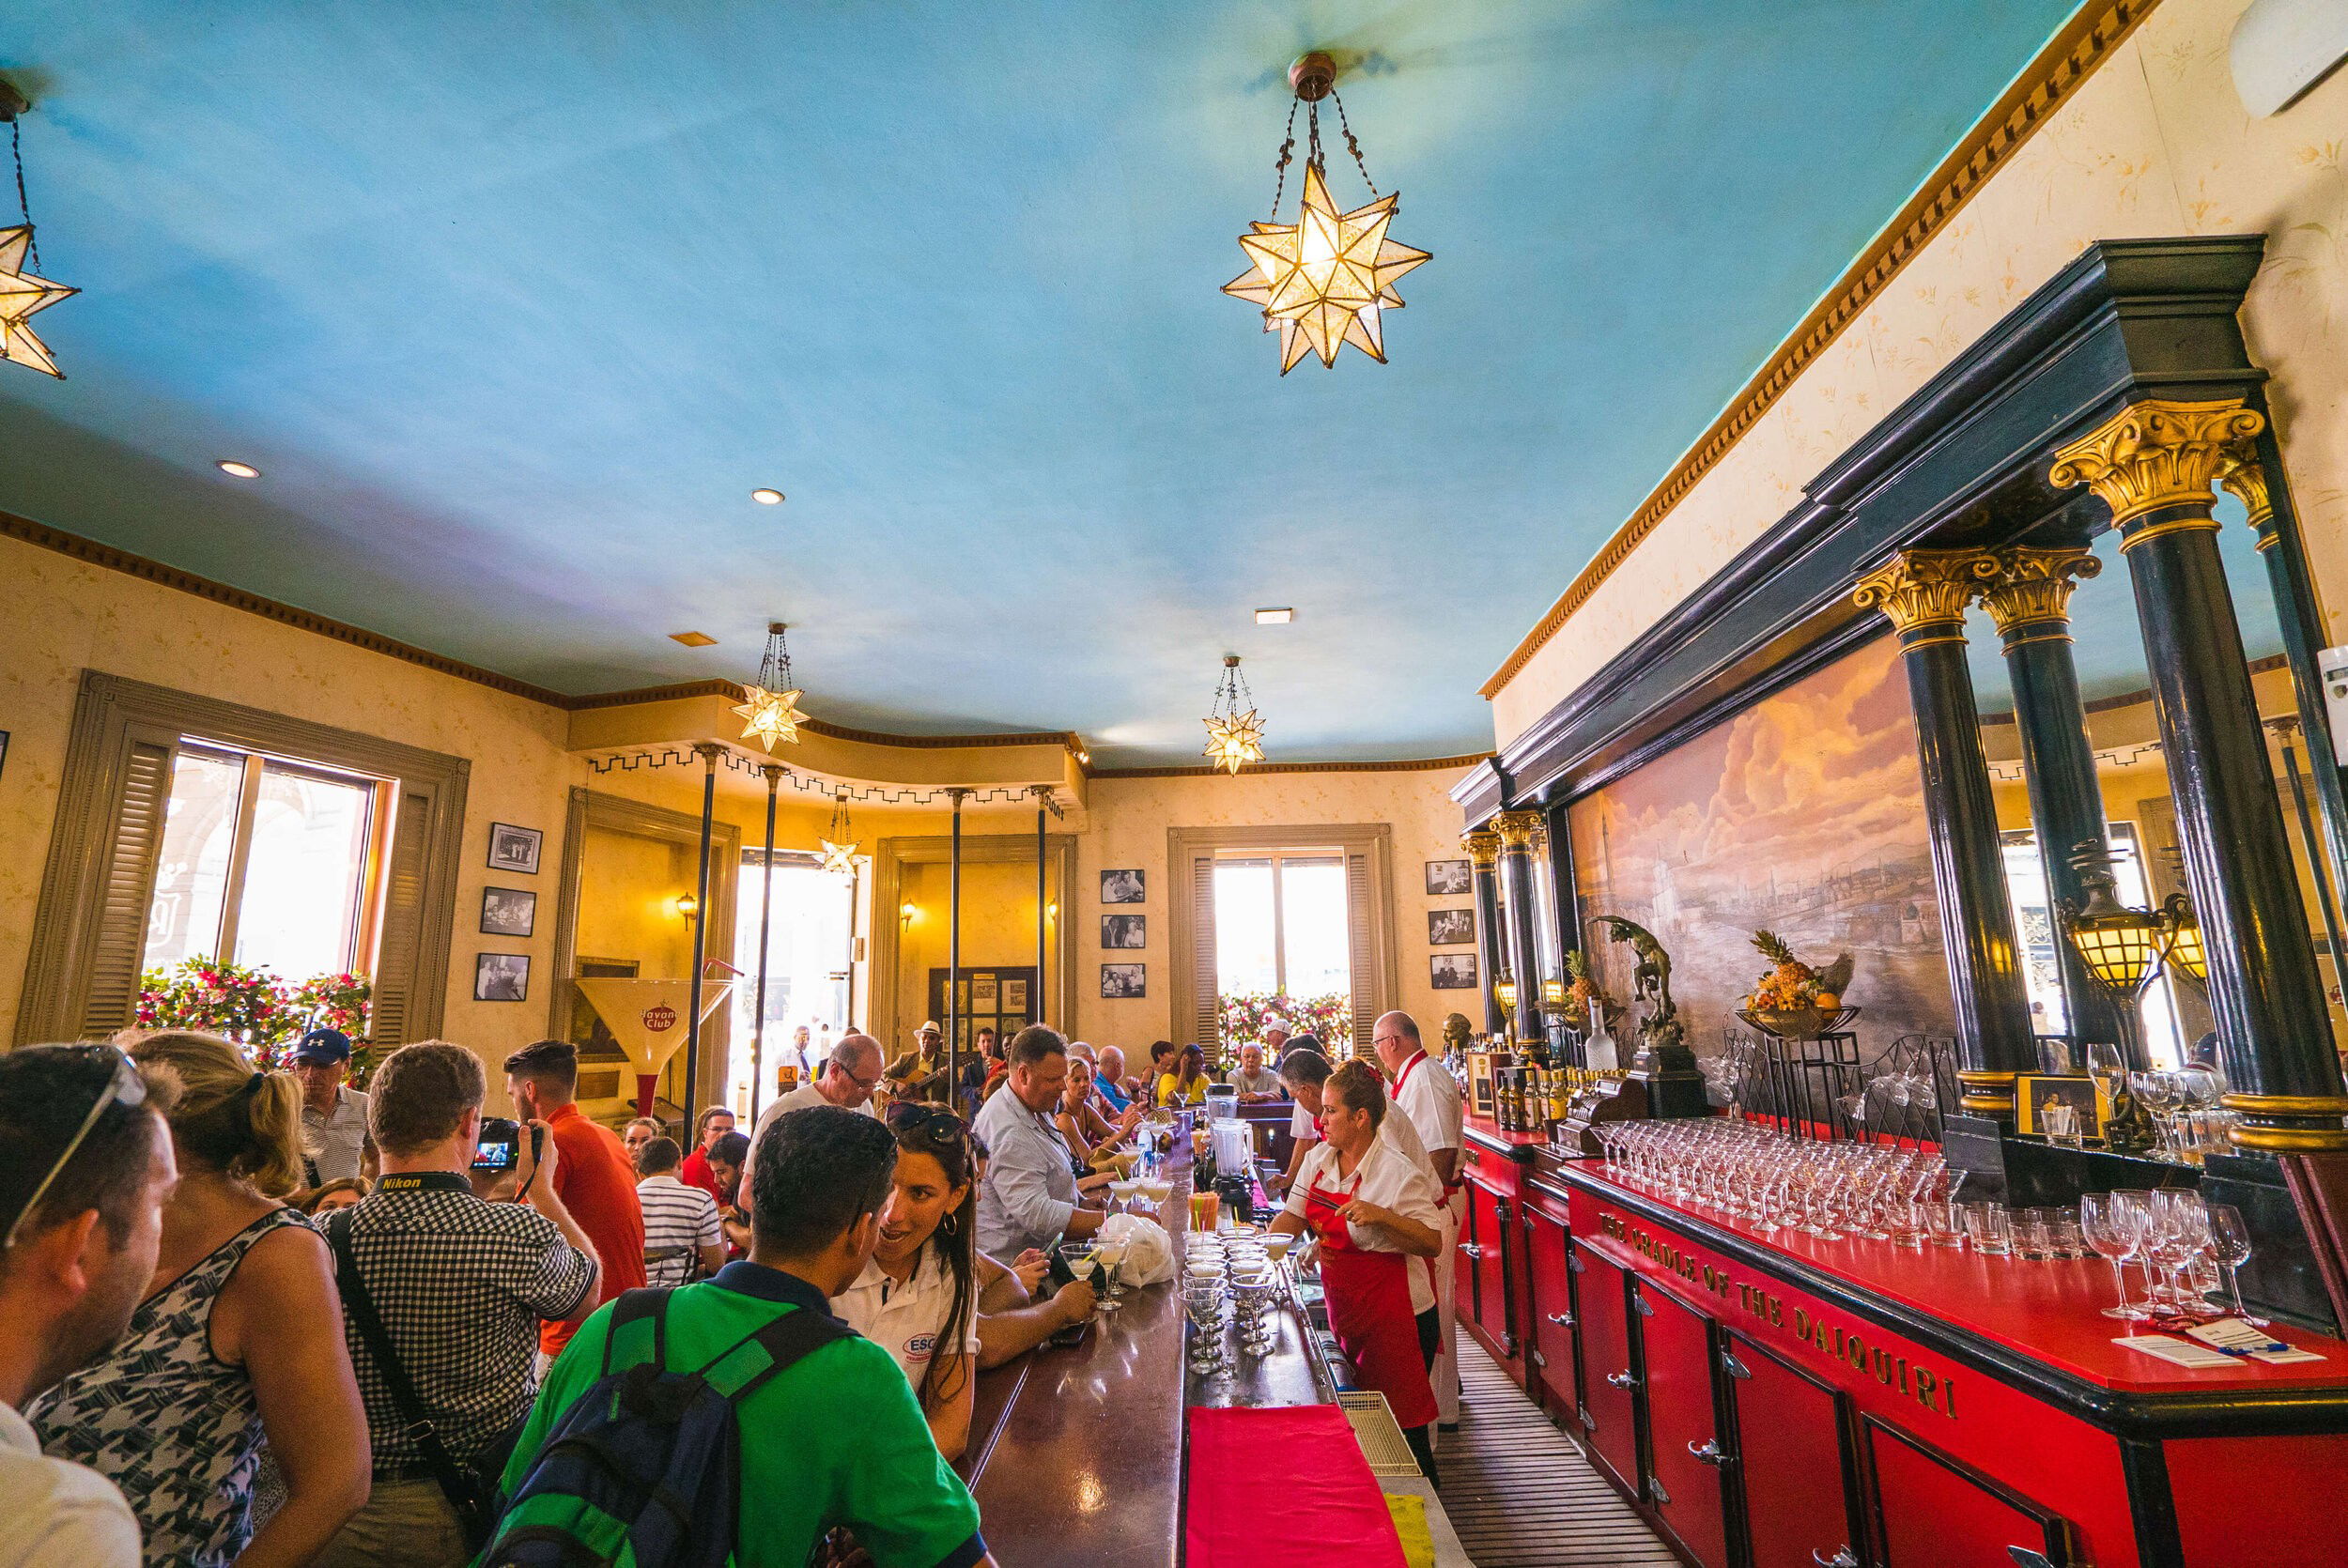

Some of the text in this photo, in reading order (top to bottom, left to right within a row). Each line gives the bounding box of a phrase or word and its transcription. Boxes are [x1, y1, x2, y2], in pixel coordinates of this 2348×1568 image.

[646, 1019, 671, 1028] Club
[382, 1178, 422, 1190] Nikon
[1599, 1212, 1958, 1420] THE CRADLE OF THE DAIQUIRI
